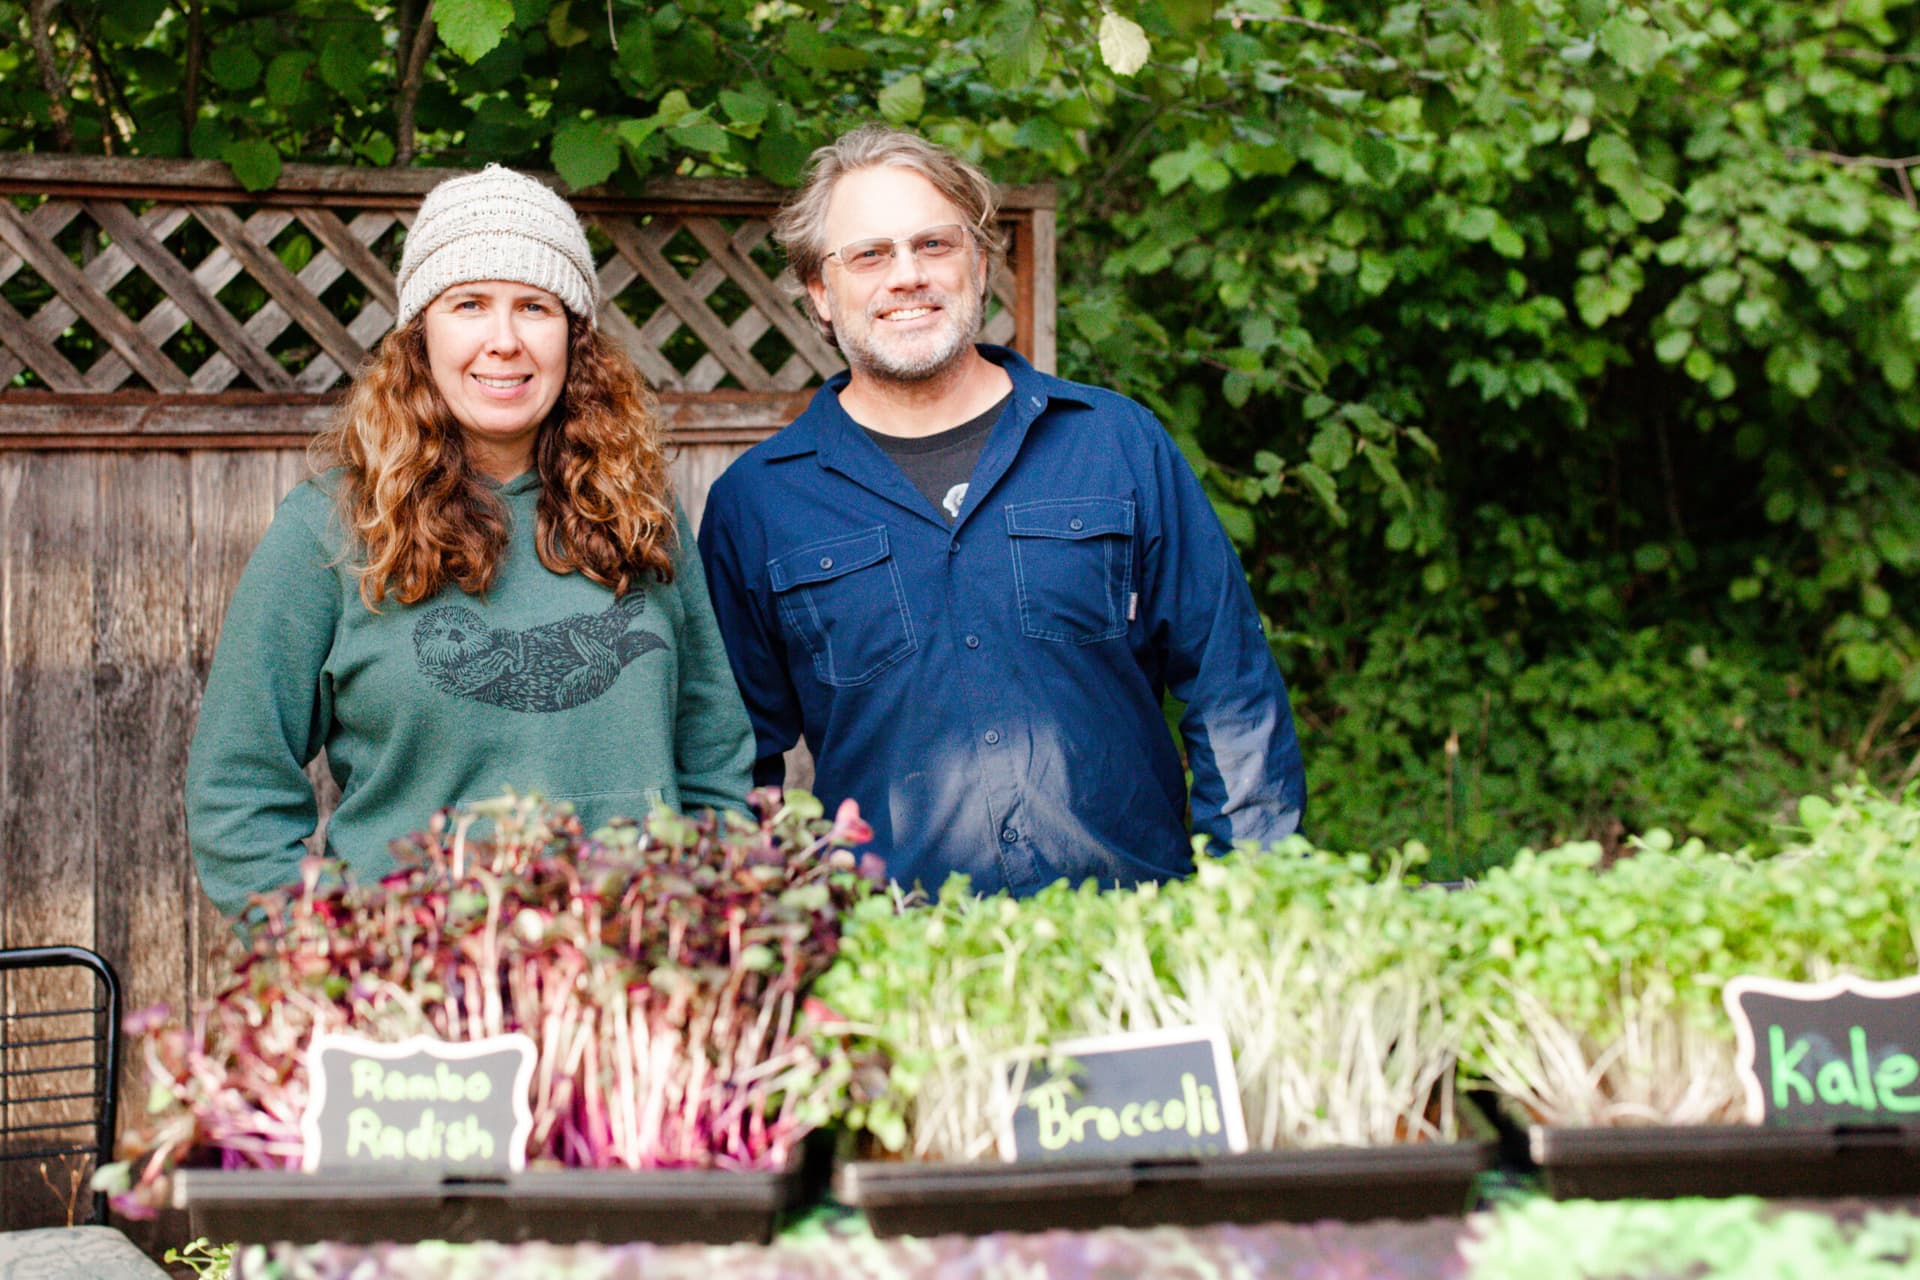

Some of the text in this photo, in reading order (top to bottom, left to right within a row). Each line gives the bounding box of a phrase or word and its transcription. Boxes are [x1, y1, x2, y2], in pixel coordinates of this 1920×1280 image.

[1768, 1023, 1920, 1112] Kale
[346, 1107, 494, 1161] Radish
[1028, 1072, 1220, 1149] Broccoli
